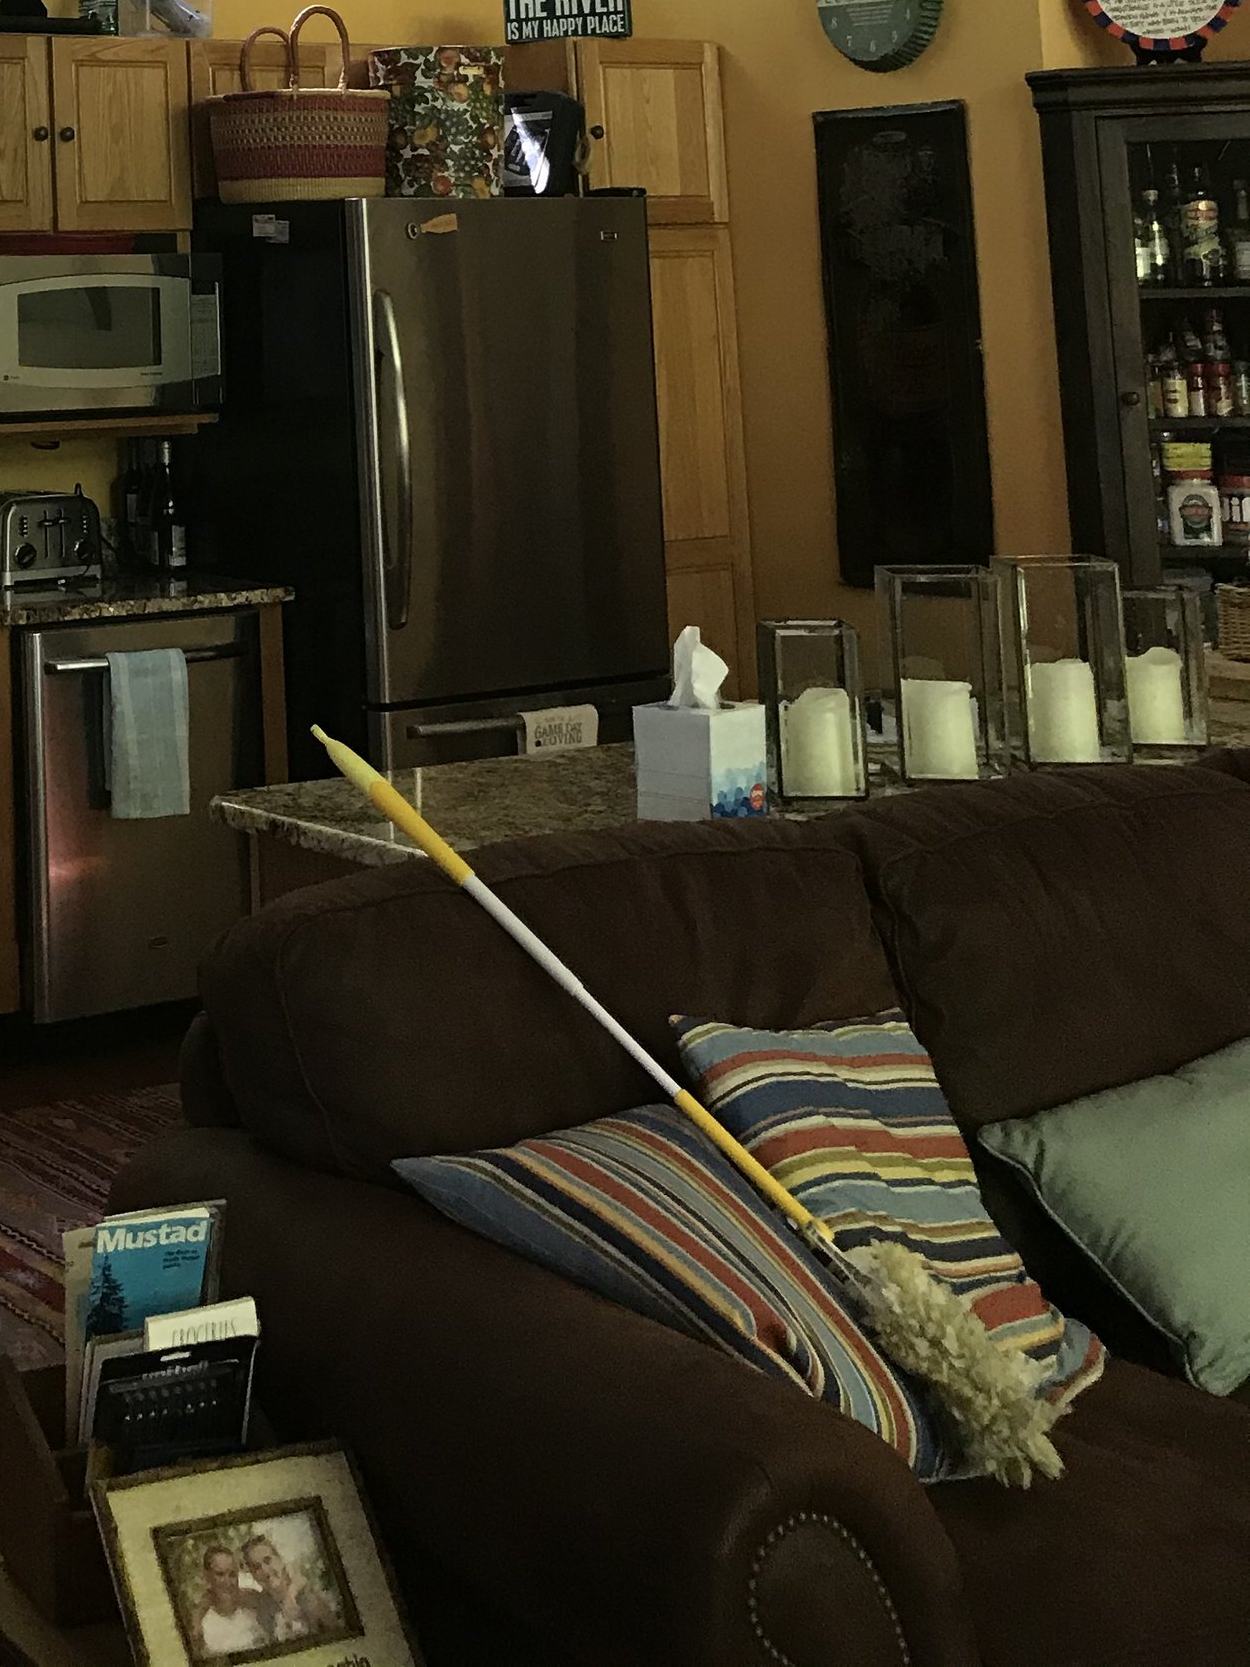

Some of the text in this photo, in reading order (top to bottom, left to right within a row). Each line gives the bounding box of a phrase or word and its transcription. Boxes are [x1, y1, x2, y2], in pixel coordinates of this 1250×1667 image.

[507, 14, 625, 40] IS MY HAPPY PLACE
[96, 1220, 208, 1254] Mustad
